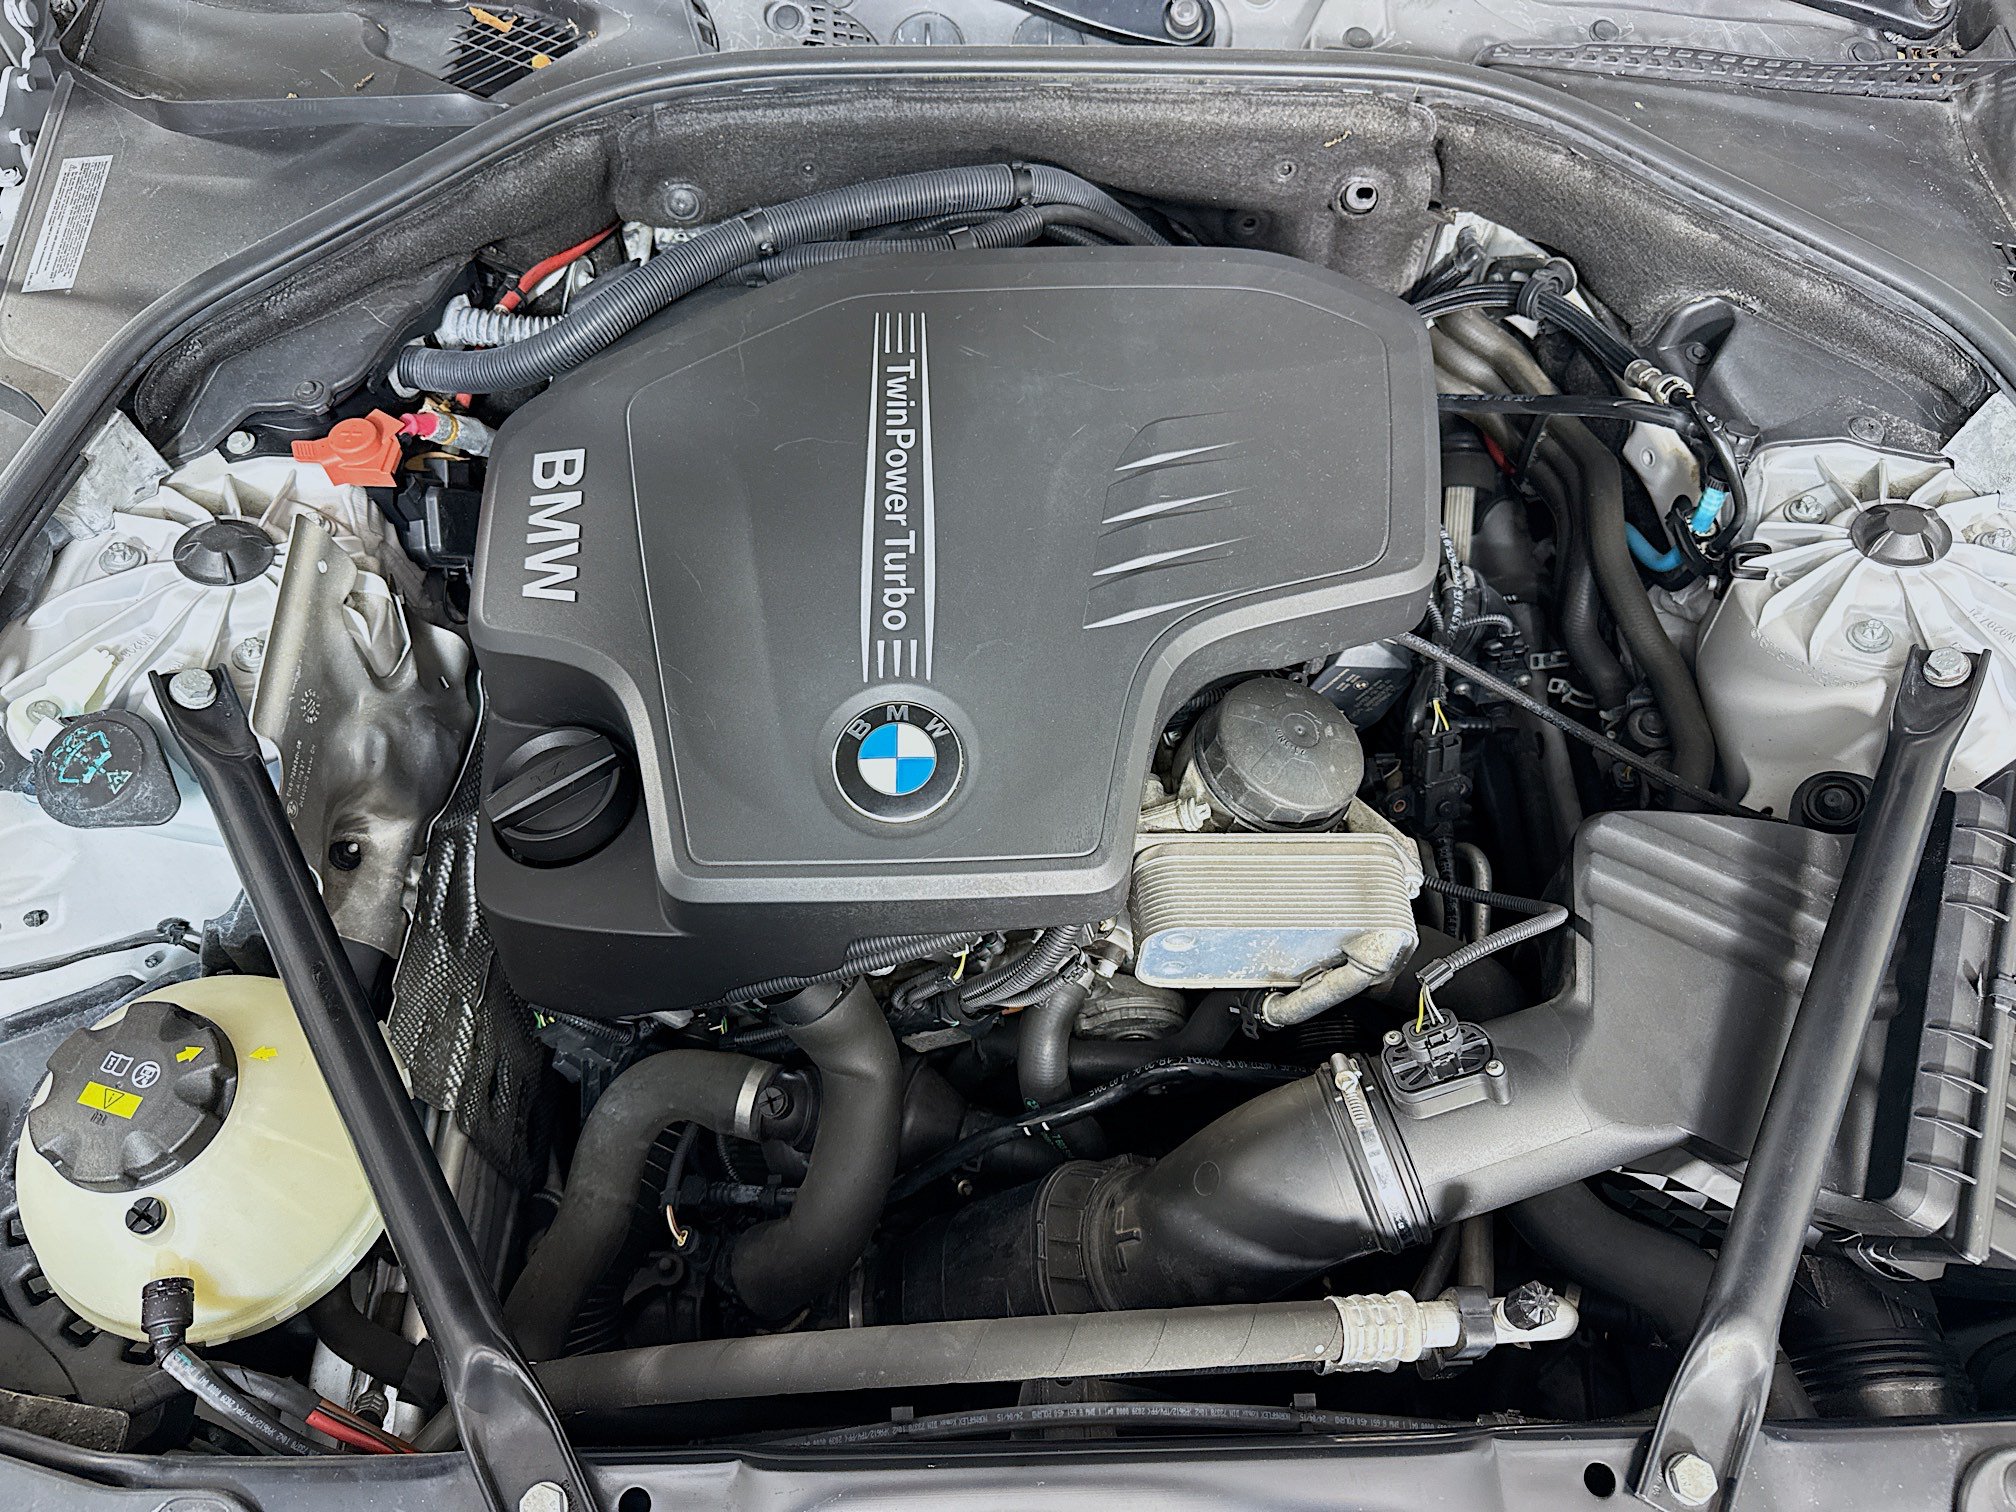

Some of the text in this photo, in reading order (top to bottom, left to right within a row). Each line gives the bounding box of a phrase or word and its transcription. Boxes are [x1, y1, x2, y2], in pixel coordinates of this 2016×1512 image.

[522, 448, 586, 602] BMW
[882, 359, 916, 631] TwinPower Turbo
[846, 704, 951, 741] BMW
[1334, 1415, 1355, 1425] POLAND
